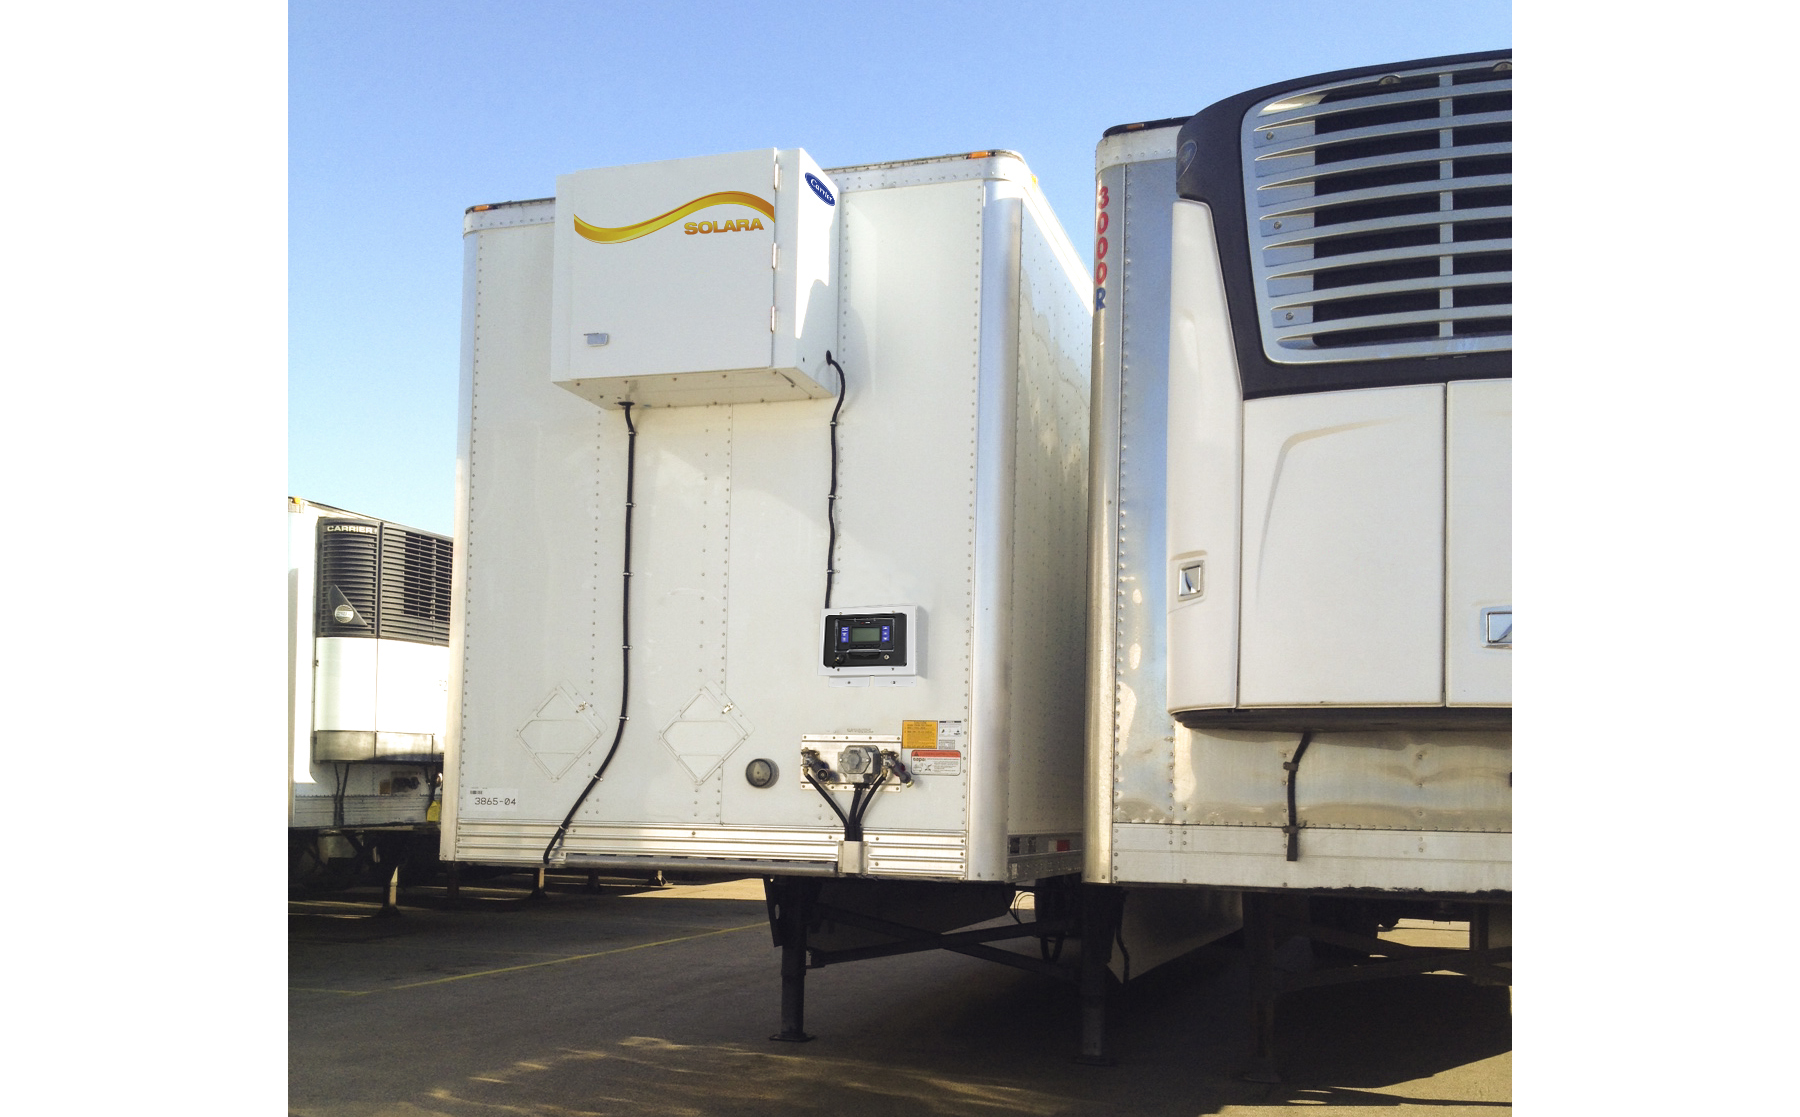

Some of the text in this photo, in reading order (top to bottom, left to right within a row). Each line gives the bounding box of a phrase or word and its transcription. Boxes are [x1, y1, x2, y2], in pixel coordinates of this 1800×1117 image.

[810, 178, 833, 202] Carrier
[684, 218, 765, 235] SOLARA
[327, 525, 373, 534] CARRIER
[474, 797, 516, 806] 3865-04
